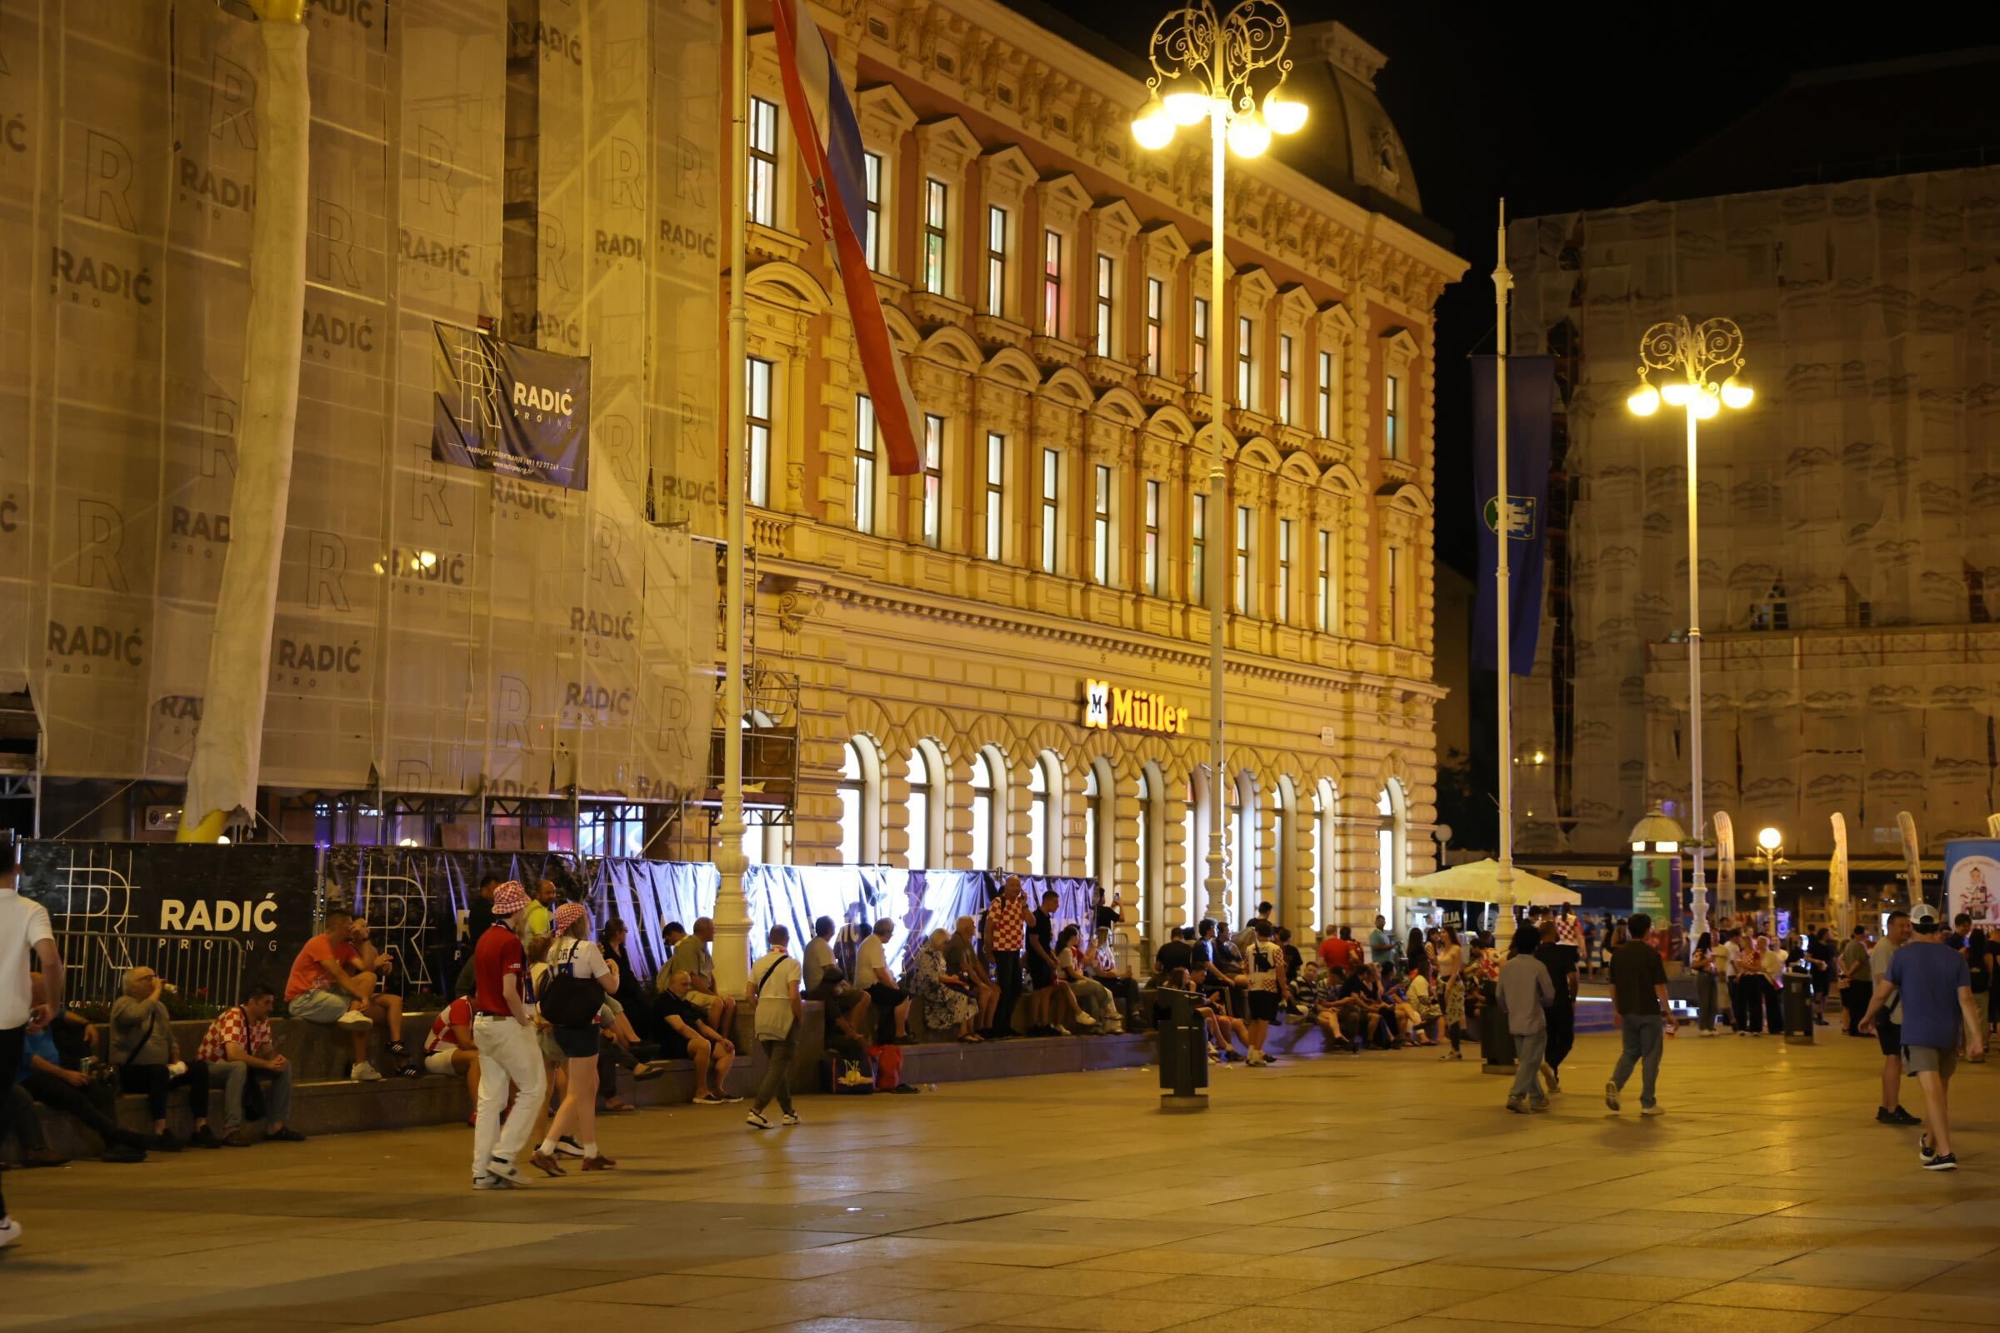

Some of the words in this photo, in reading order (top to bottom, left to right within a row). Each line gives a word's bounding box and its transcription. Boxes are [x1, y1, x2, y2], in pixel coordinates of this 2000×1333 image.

[180, 157, 256, 212] RADI
[399, 228, 470, 277] RADIĆ
[595, 230, 642, 260] RADI
[660, 219, 716, 259] RADIĆ
[51, 246, 153, 306] RADIĆ
[514, 381, 573, 417] RADIĆ
[490, 475, 557, 520] RADIĆ
[662, 475, 717, 507] RADIĆ
[171, 505, 231, 542] RAD
[47, 619, 143, 667] RADIĆ
[570, 607, 635, 641] RADIĆ
[277, 639, 362, 674] RADIĆ
[565, 682, 632, 716] RADIĆ
[1111, 687, 1189, 734] Müller
[160, 893, 278, 933] RADIĆ
